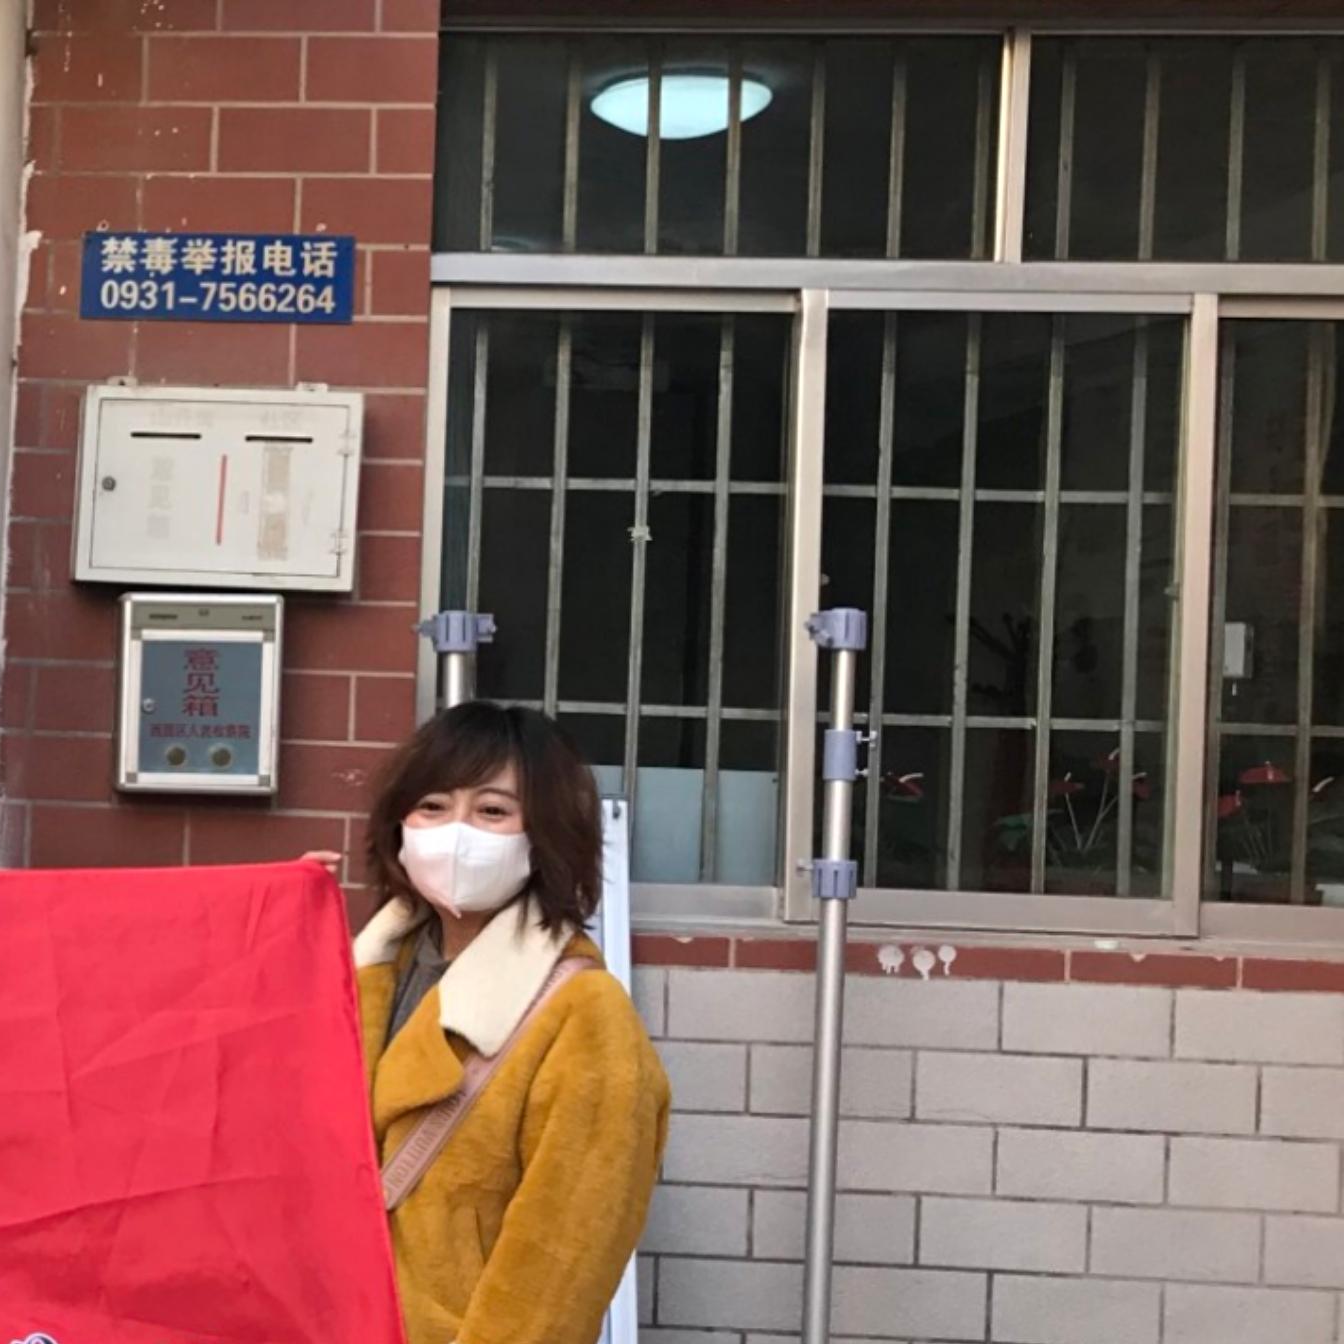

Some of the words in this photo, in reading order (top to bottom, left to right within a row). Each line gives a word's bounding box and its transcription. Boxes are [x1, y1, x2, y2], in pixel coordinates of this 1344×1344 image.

[100, 237, 338, 279] 禁毒举报电话
[99, 280, 336, 314] 0931-7566264
[181, 648, 221, 717] 意见箱
